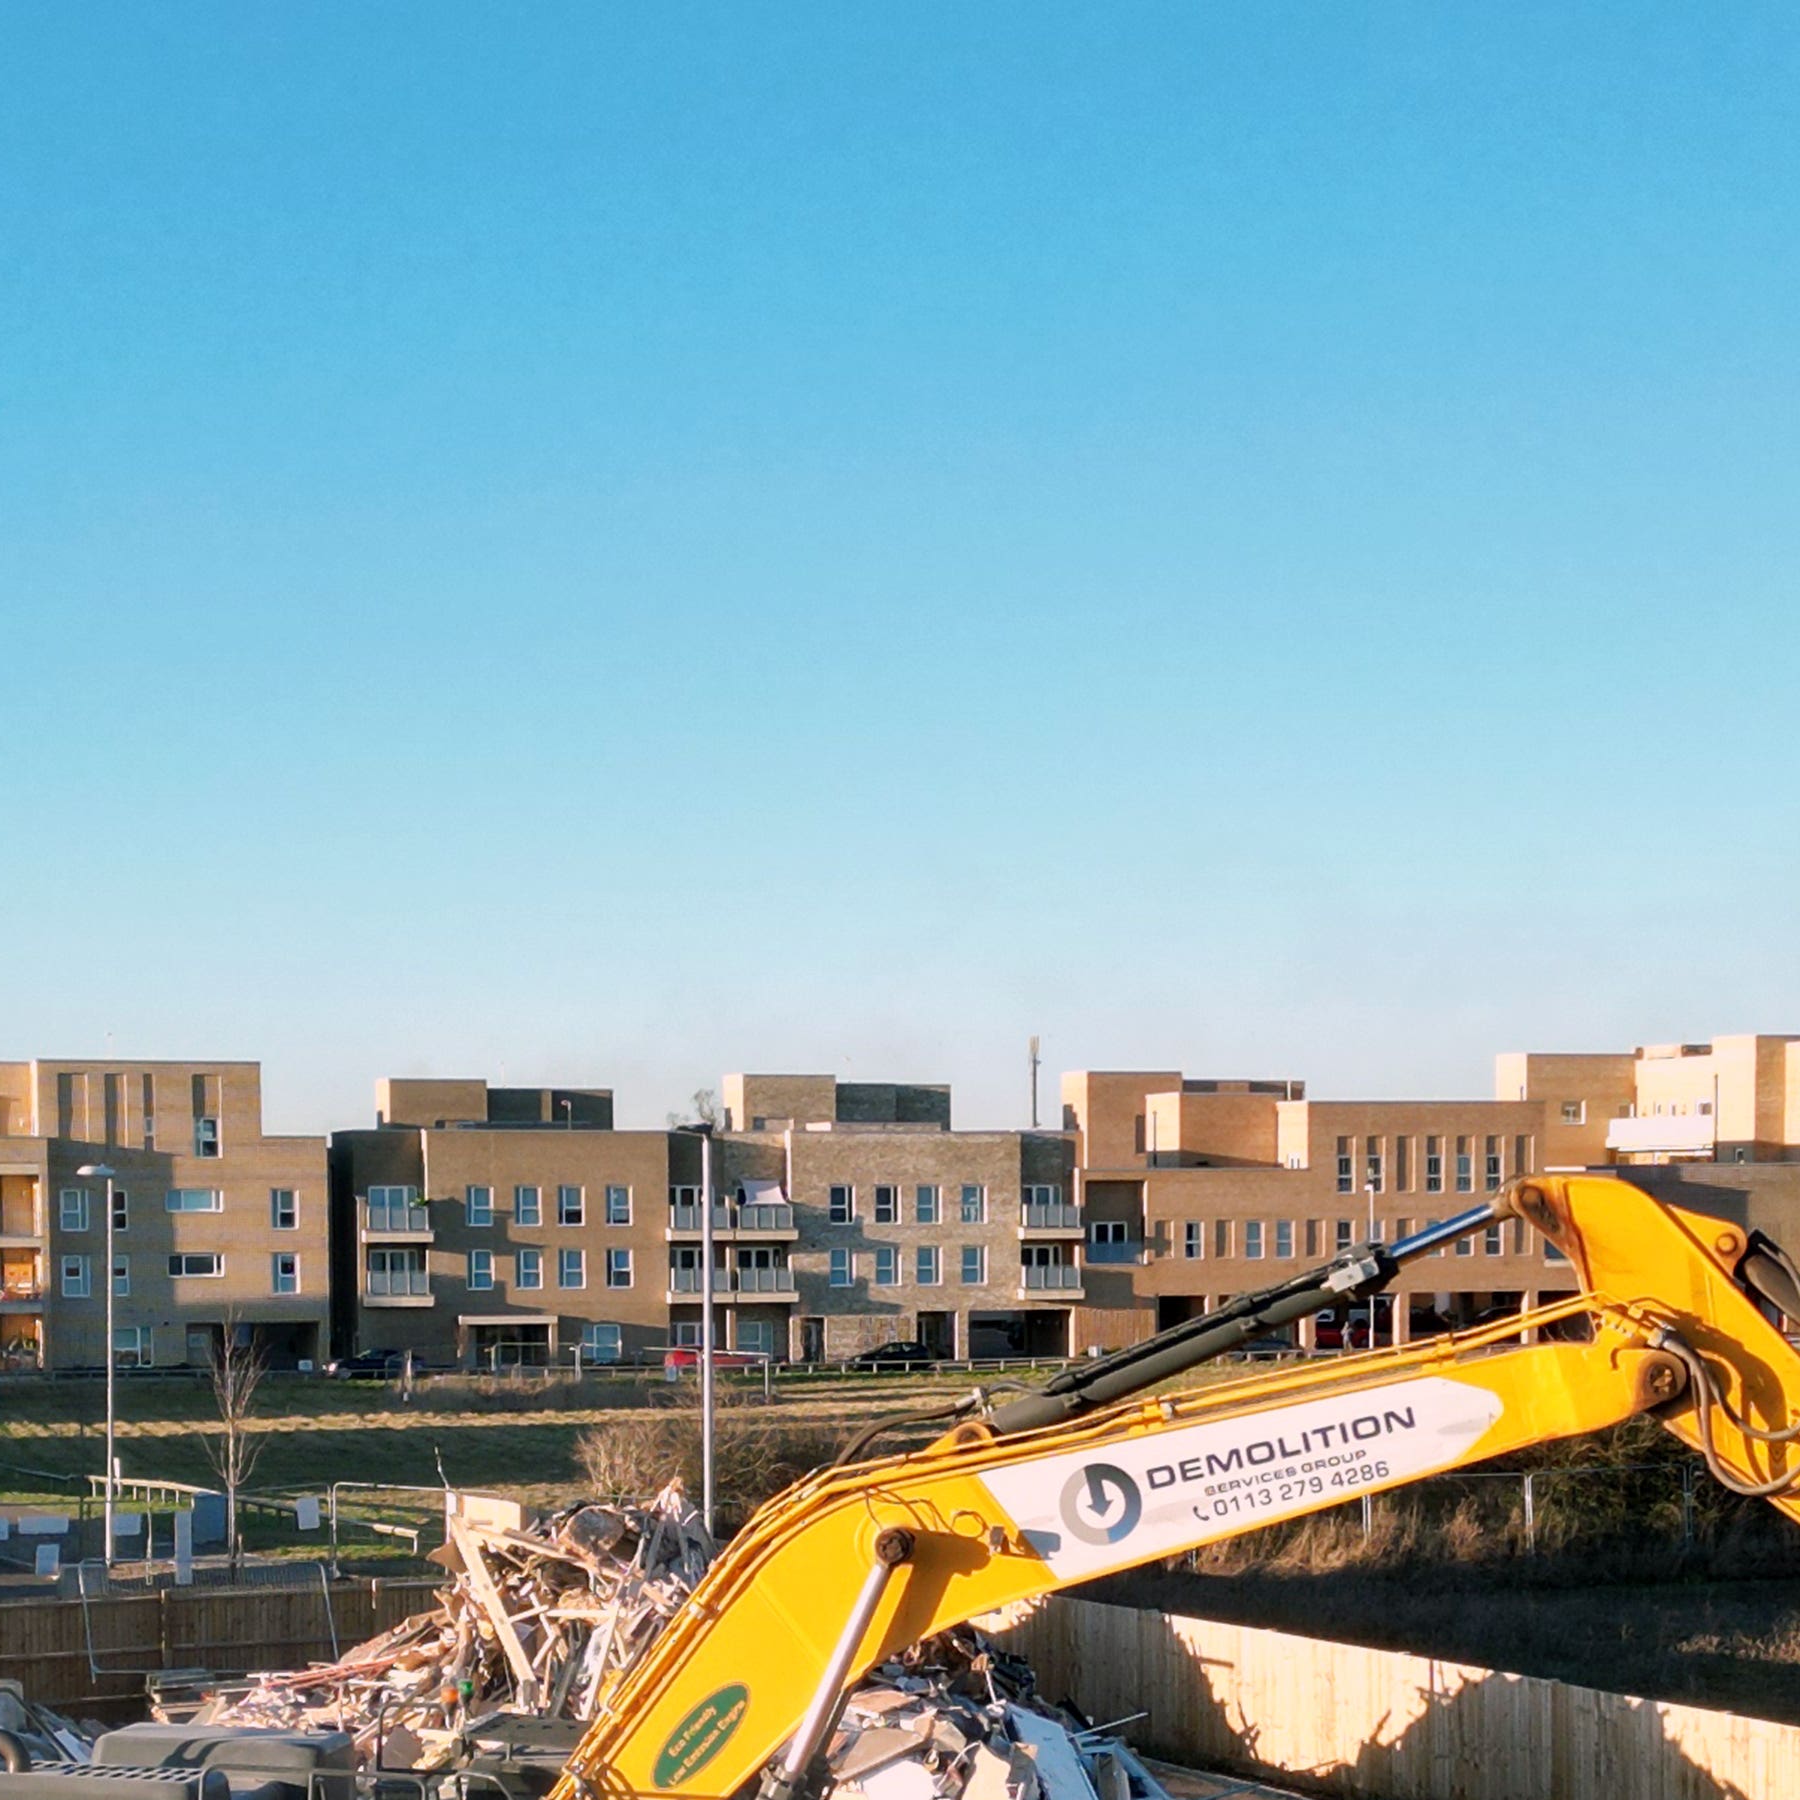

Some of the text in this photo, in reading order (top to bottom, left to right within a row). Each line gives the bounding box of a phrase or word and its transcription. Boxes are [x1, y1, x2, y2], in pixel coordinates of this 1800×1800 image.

[1146, 1406, 1416, 1490] DEMOLITION
[1204, 1449, 1367, 1497] SERVICES GROUP
[1213, 1460, 1390, 1517] 0113 279 4286
[669, 1739, 685, 1757] Eco
